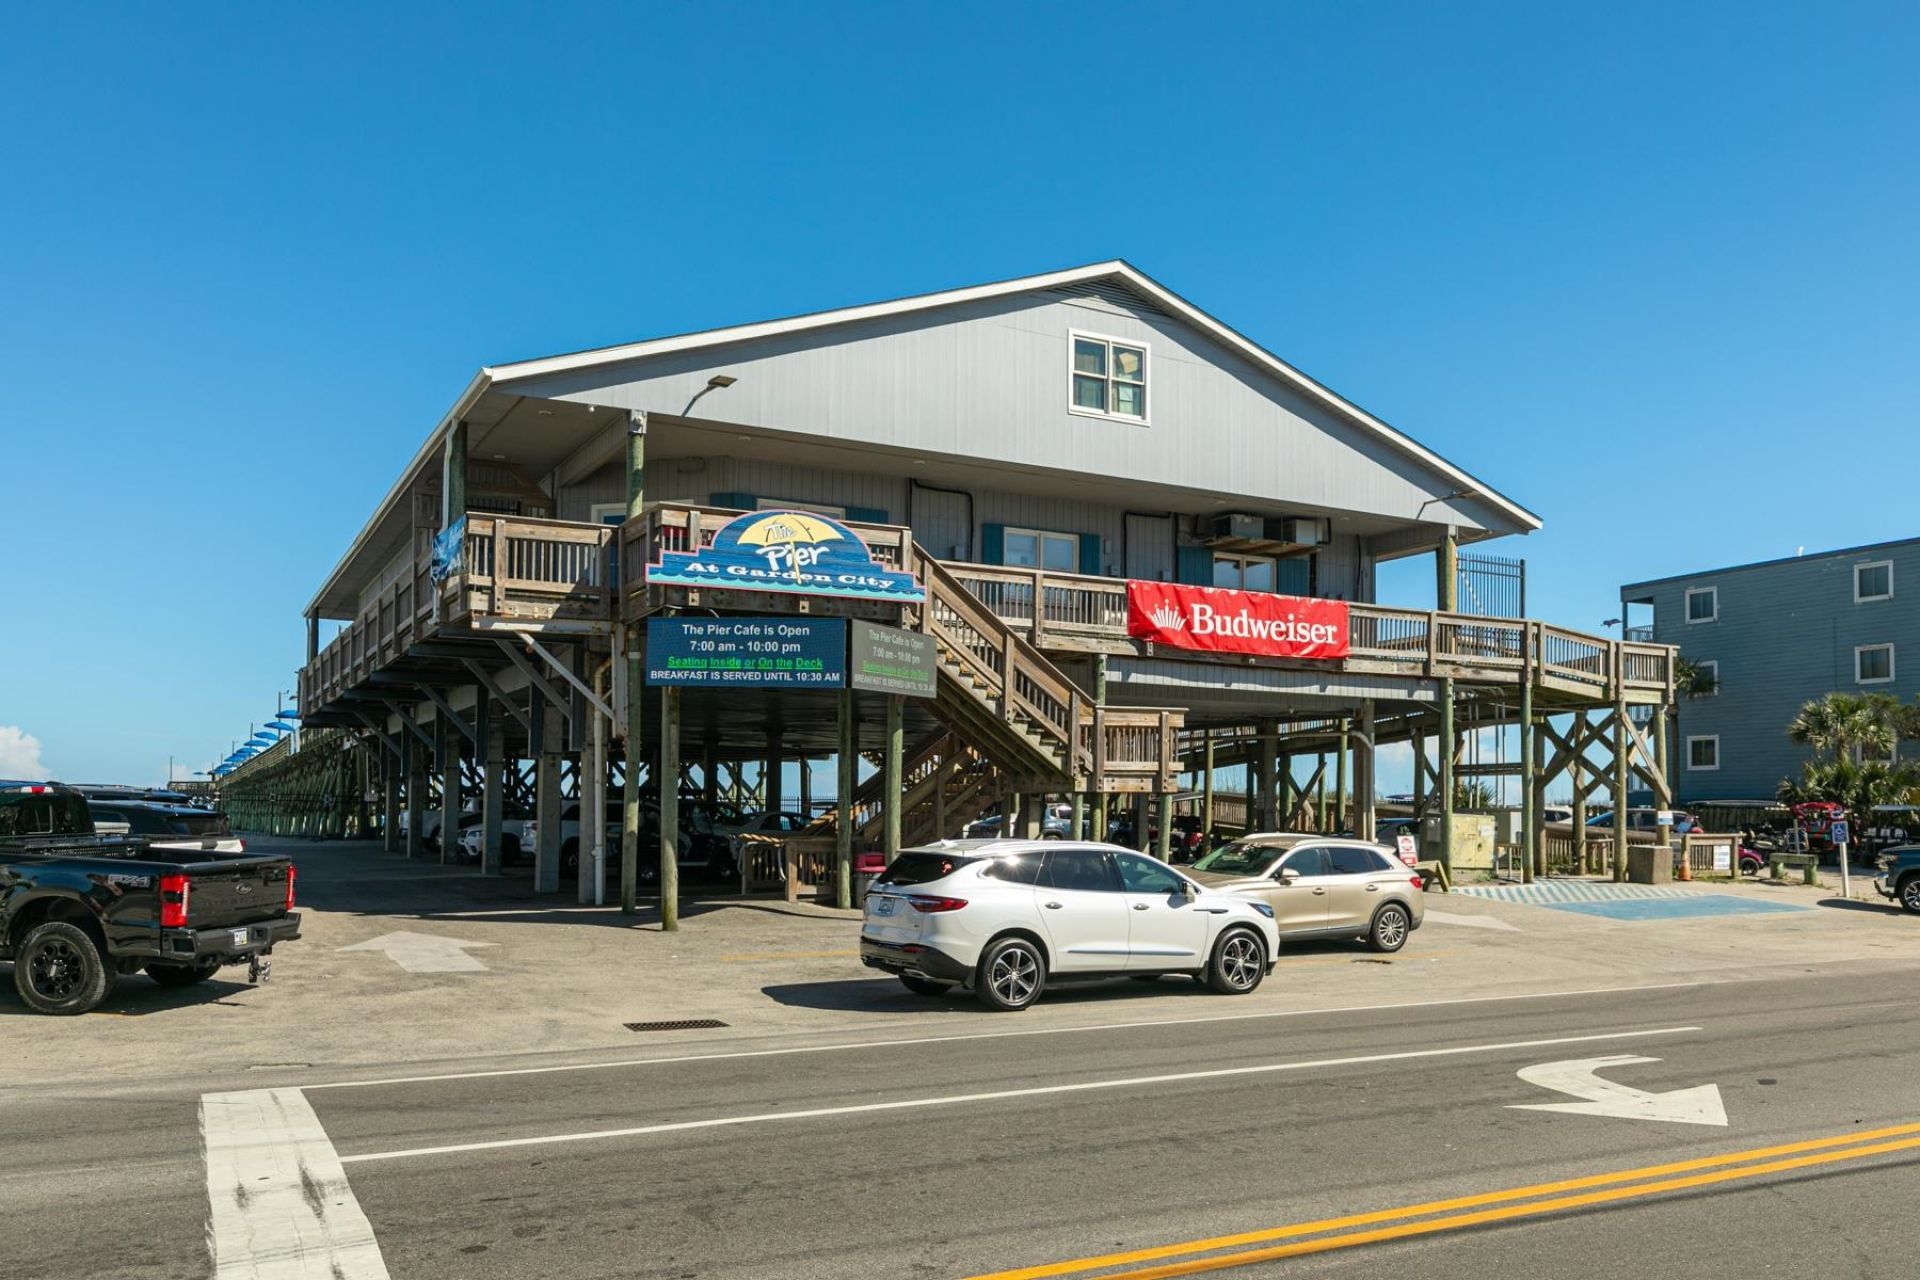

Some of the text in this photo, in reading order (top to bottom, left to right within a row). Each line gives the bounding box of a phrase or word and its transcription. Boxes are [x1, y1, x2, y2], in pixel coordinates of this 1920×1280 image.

[764, 522, 797, 541] The
[755, 544, 830, 571] Pier
[685, 562, 896, 589] At Garden City
[682, 624, 810, 638] The Pier Cafe is Open
[1190, 603, 1338, 645] Budweiser
[690, 641, 715, 652] 7:00
[718, 642, 736, 652] am
[747, 641, 779, 653] 10:00
[782, 643, 801, 655] pm
[667, 656, 823, 670] Seating Inside or On the Deck
[650, 670, 841, 681] BREAKFAST IS SERVED UNTIL 10:30 AM
